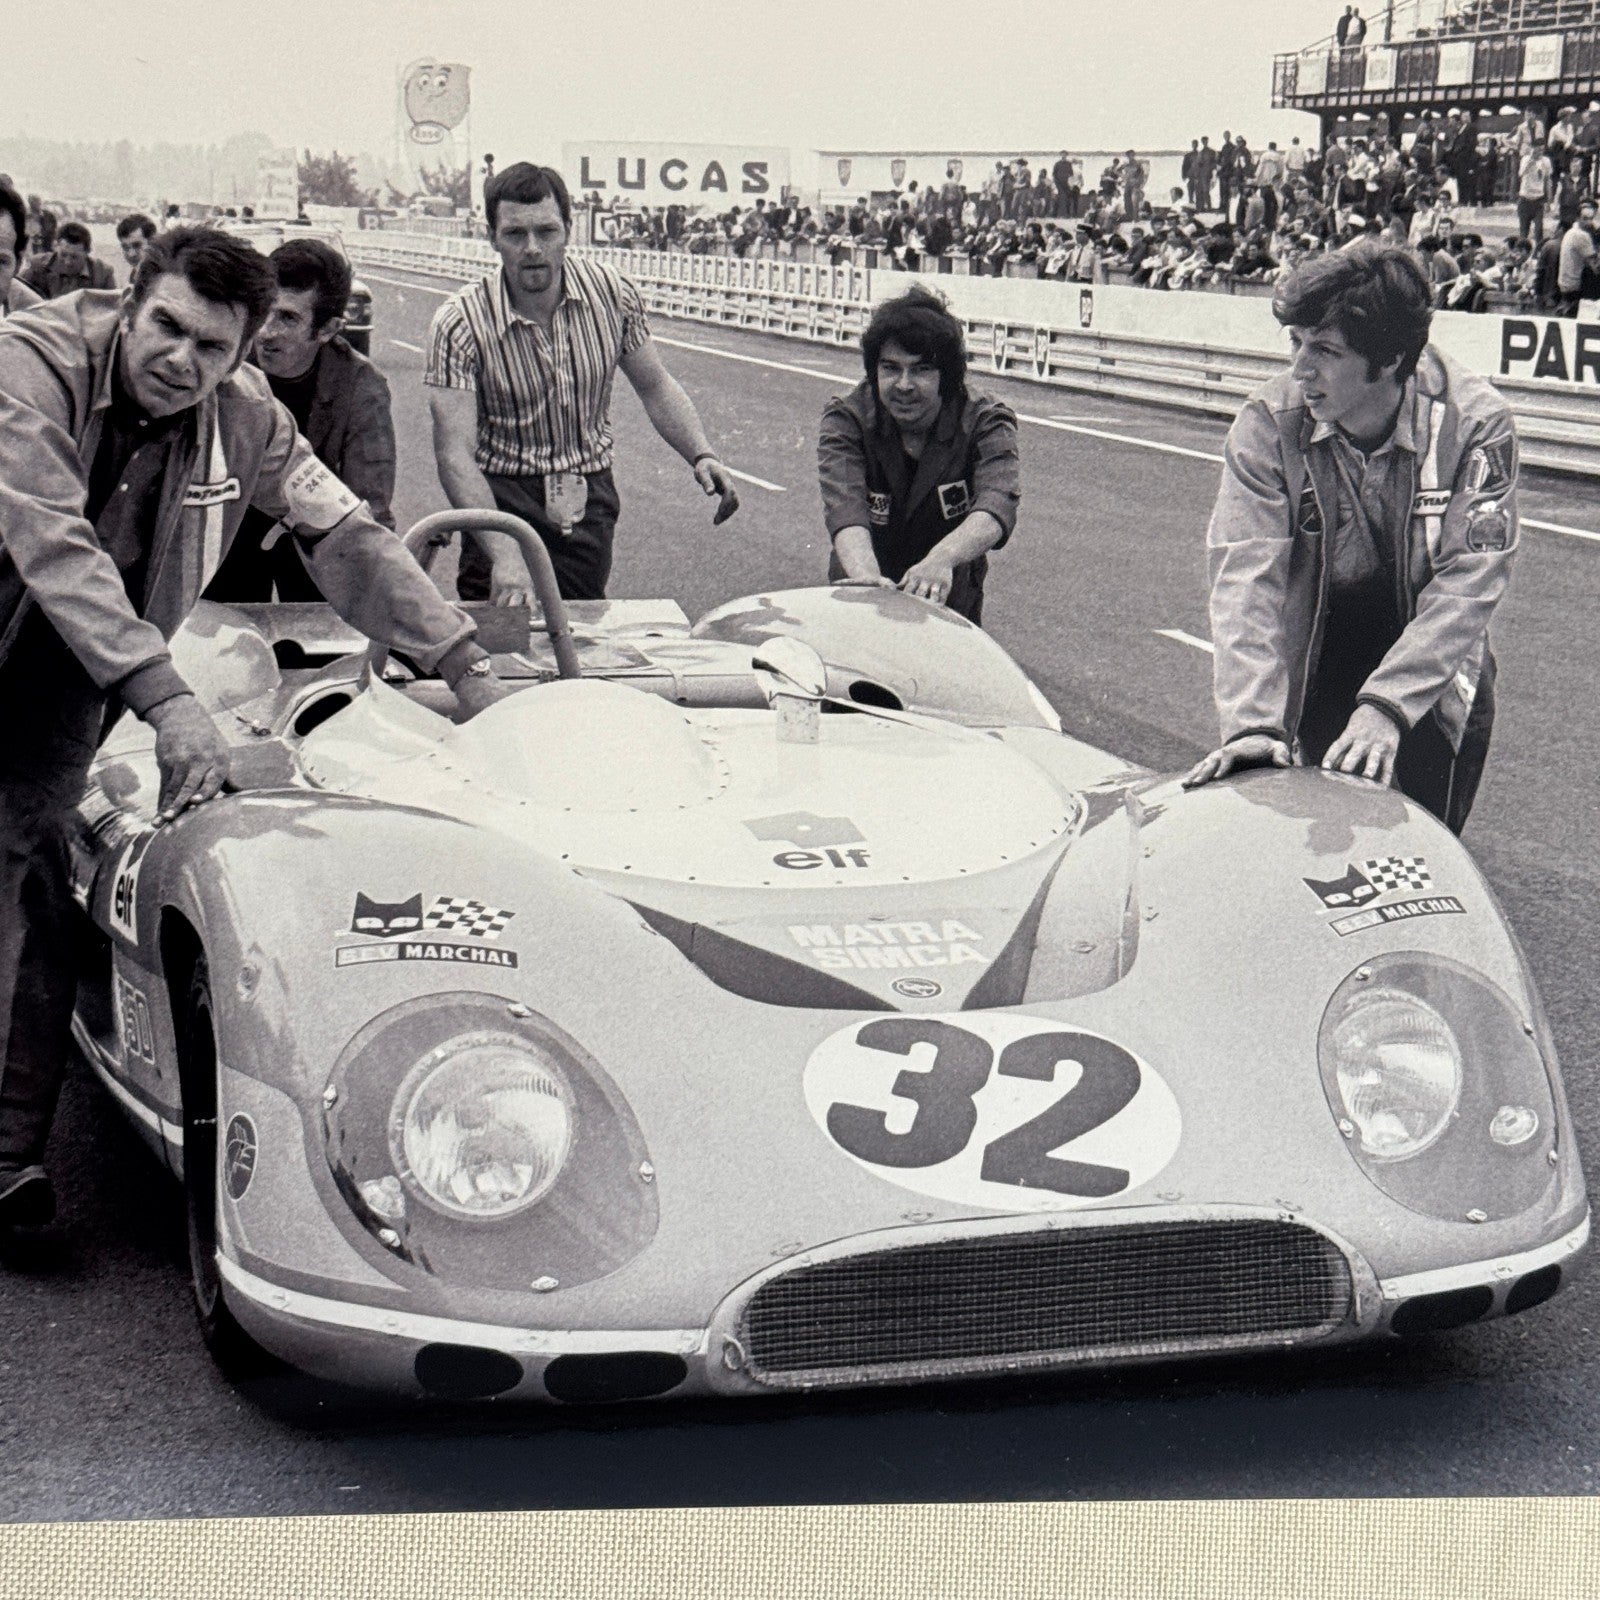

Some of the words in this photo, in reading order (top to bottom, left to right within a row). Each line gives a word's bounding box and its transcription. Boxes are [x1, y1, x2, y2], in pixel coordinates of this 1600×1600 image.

[580, 156, 770, 194] LUCAS
[1500, 319, 1600, 384] PAR
[772, 849, 871, 870] elf
[115, 874, 134, 928] elf
[1383, 898, 1462, 920] MARCHAL
[788, 920, 983, 947] MATRA
[405, 943, 513, 967] MARCHAL
[811, 943, 992, 969] SIMCA
[826, 1018, 1142, 1198] 32
